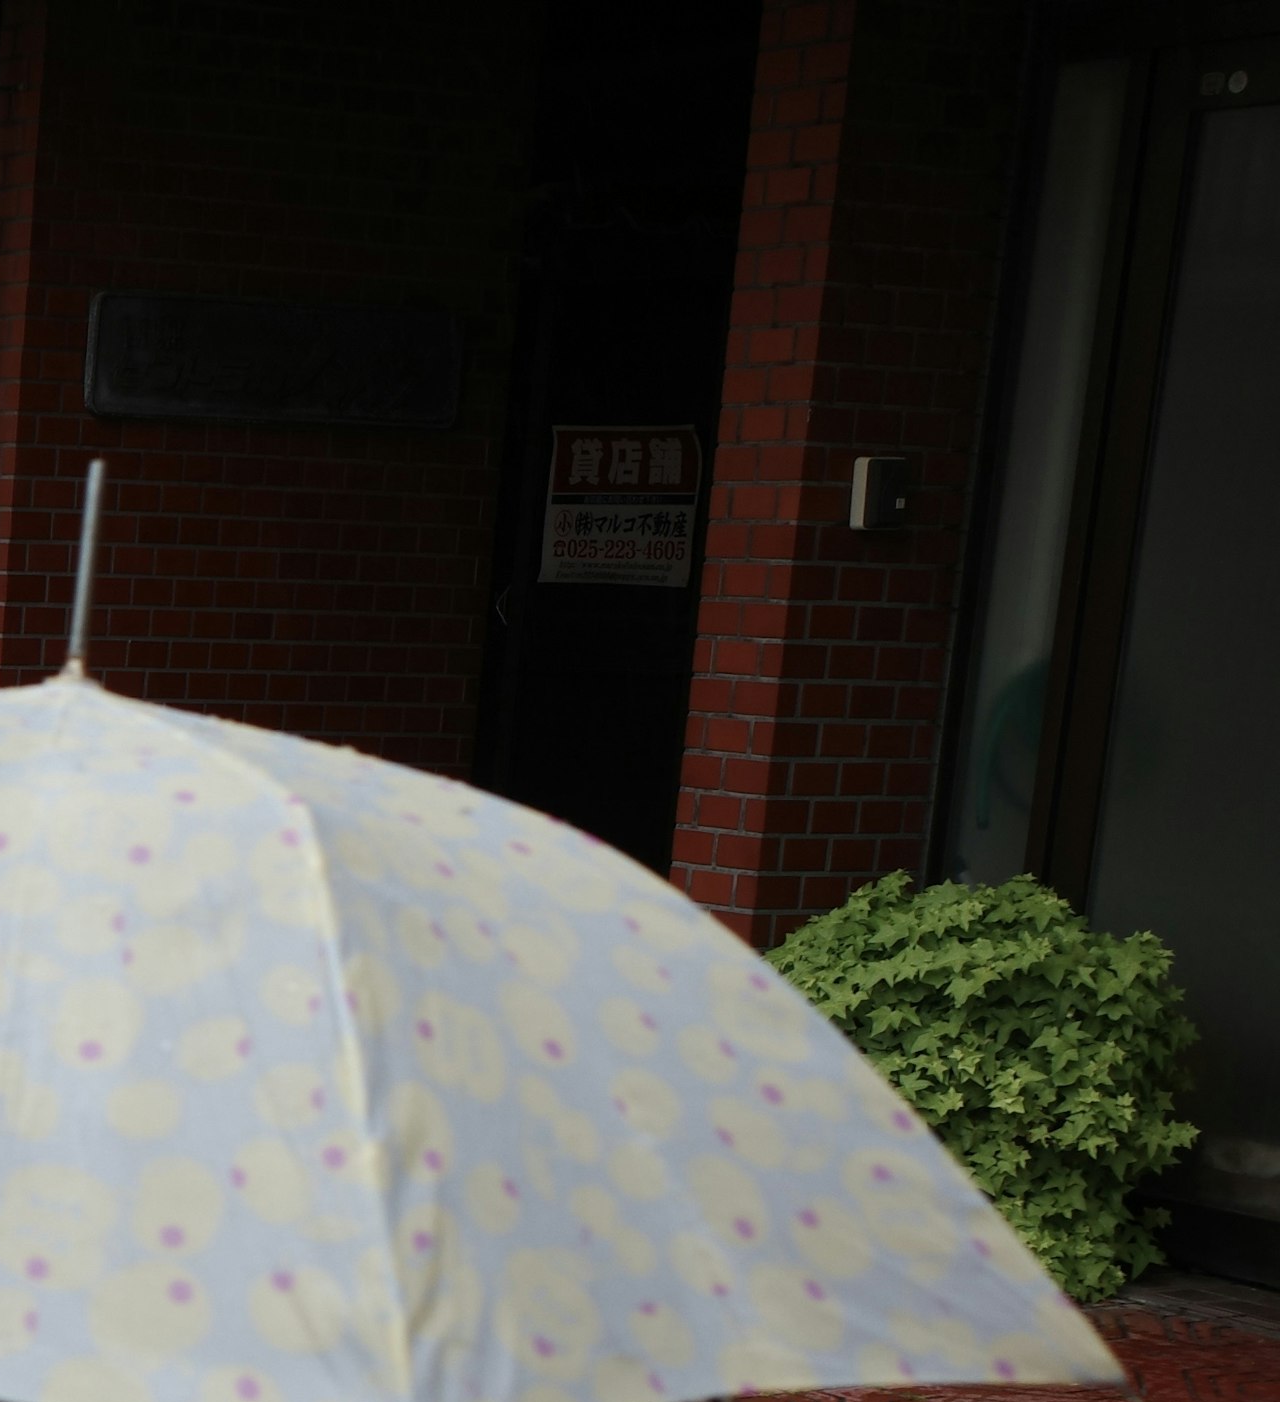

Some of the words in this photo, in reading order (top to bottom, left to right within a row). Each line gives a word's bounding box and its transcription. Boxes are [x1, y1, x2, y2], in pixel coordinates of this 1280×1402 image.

[569, 438, 682, 485] 貸店舗
[567, 539, 686, 561] 025-223-4605
